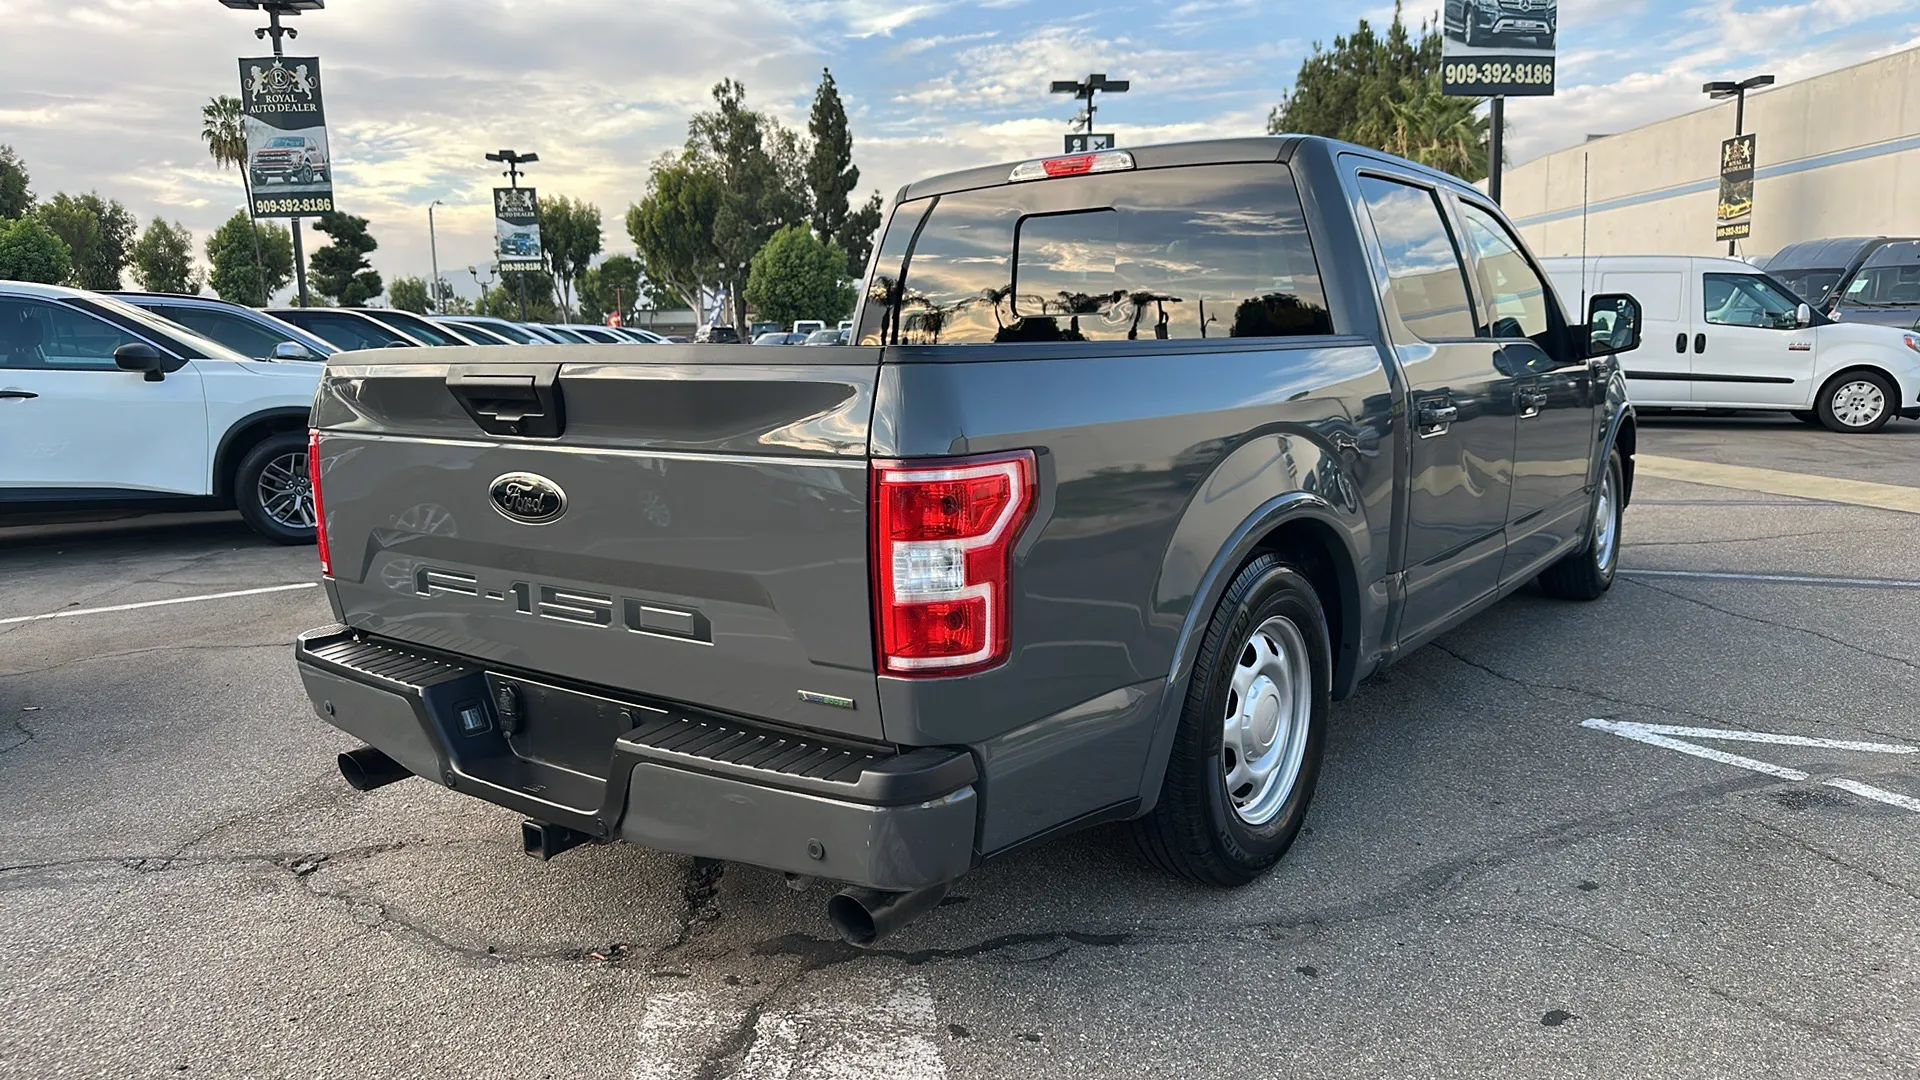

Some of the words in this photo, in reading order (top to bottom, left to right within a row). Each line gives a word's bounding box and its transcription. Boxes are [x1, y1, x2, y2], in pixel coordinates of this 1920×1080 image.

[273, 71, 283, 84] R
[1445, 63, 1552, 84] 909-392-8186
[265, 94, 297, 103] ROYAL
[249, 104, 275, 113] AUTO
[277, 103, 317, 112] DEALER
[256, 198, 331, 213] 909-392-8186
[503, 481, 545, 513] Ford
[416, 567, 714, 646] F-150
